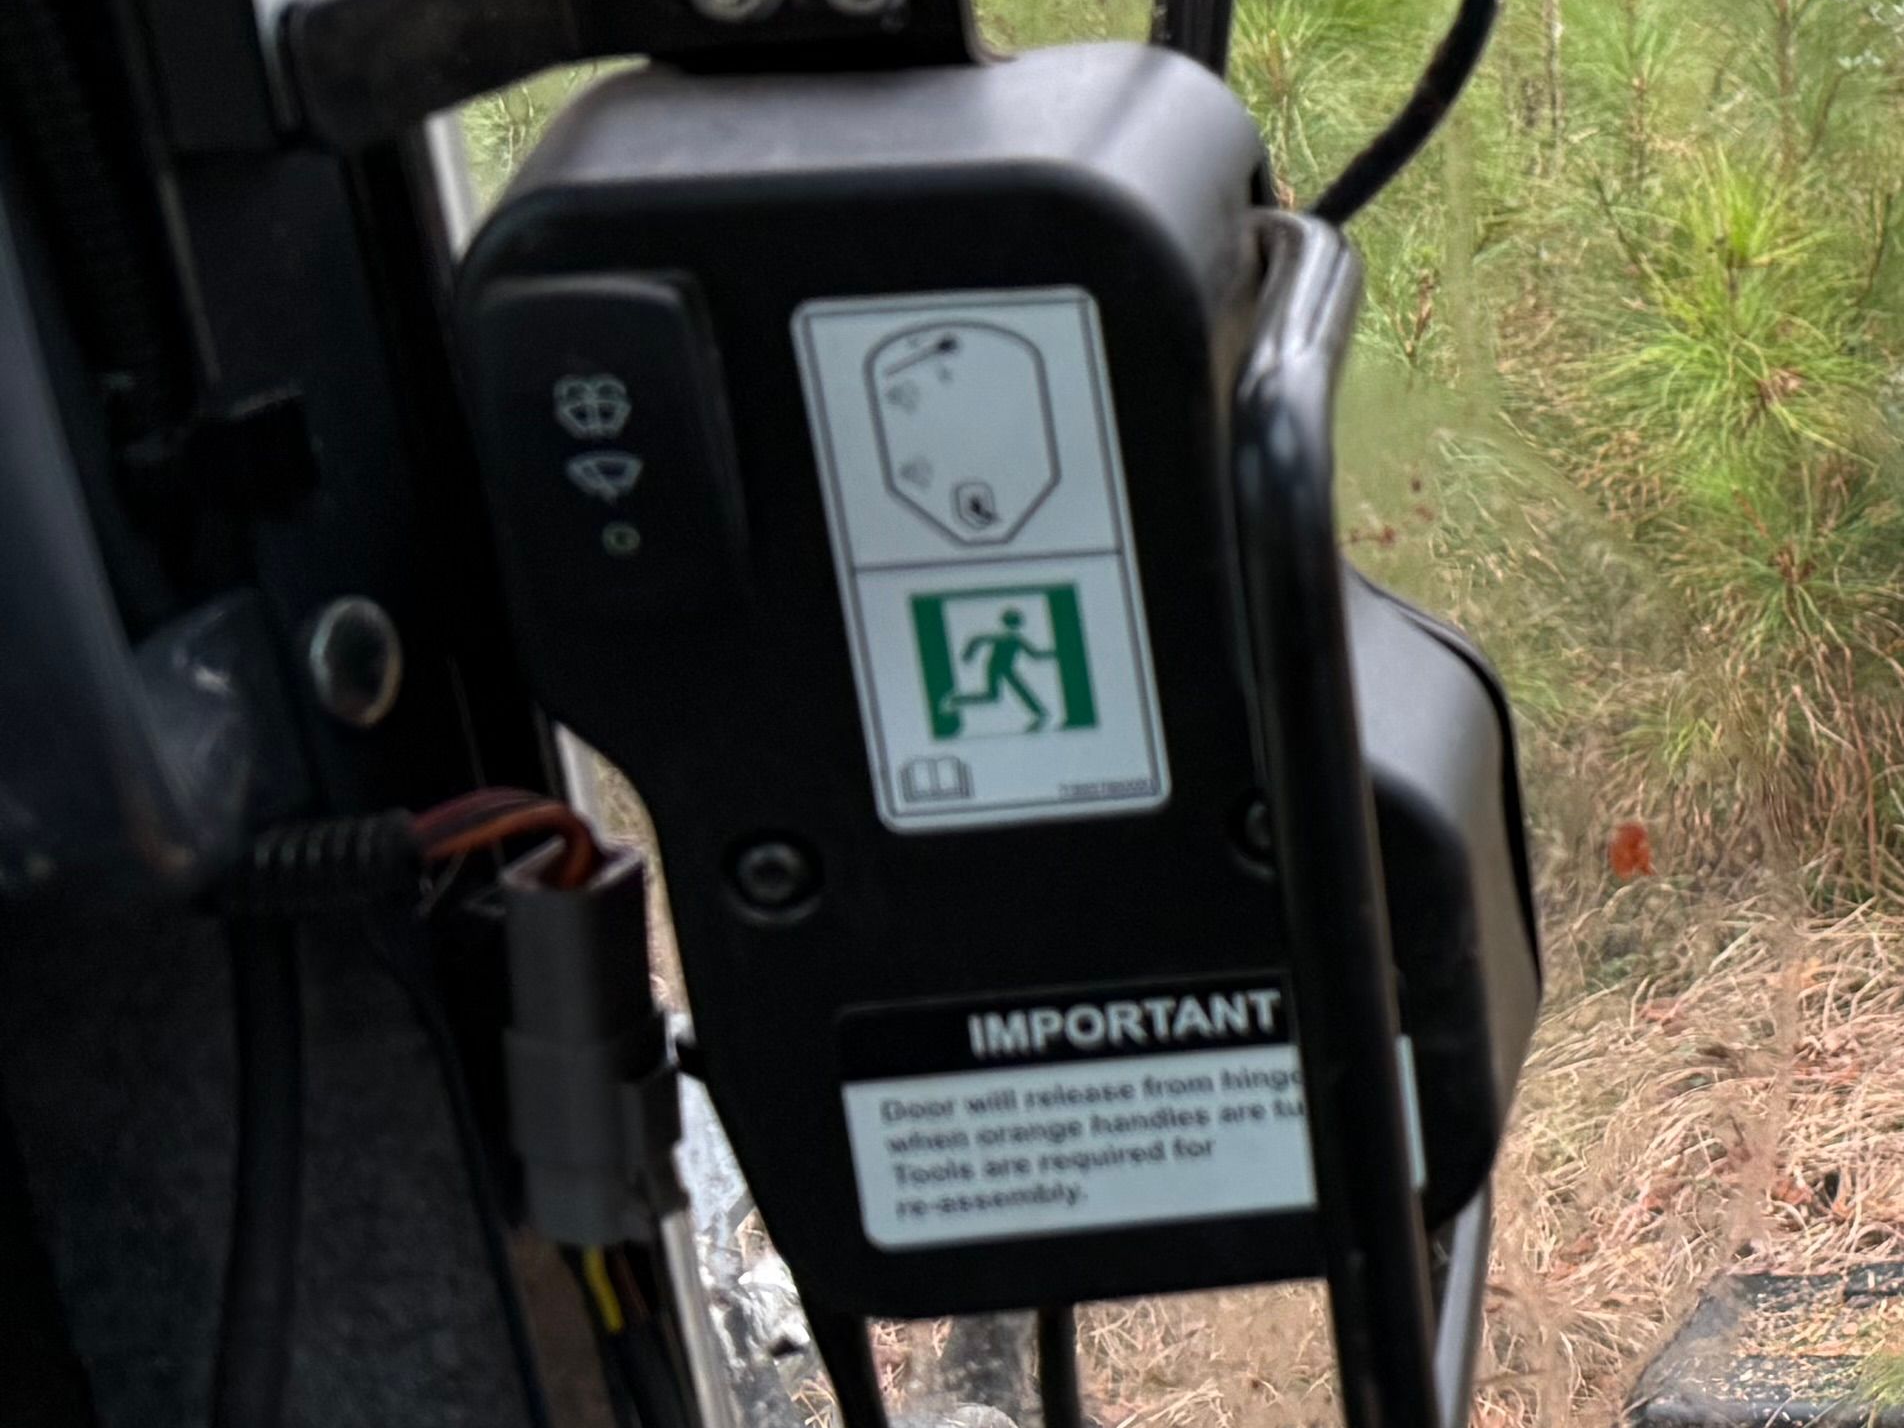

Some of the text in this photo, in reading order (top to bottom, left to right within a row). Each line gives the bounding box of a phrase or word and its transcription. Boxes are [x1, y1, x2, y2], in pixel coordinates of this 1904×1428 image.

[969, 989, 1281, 1059] IMPORTANT
[880, 1098, 954, 1124] Door
[966, 1087, 1017, 1115] will
[1023, 1082, 1135, 1112] release
[1141, 1074, 1214, 1098] from
[886, 1129, 969, 1156] when
[973, 1119, 1083, 1146] orange
[1088, 1105, 1212, 1135] handles
[1219, 1101, 1268, 1124] are
[893, 1135, 1216, 1188] Tools are required for
